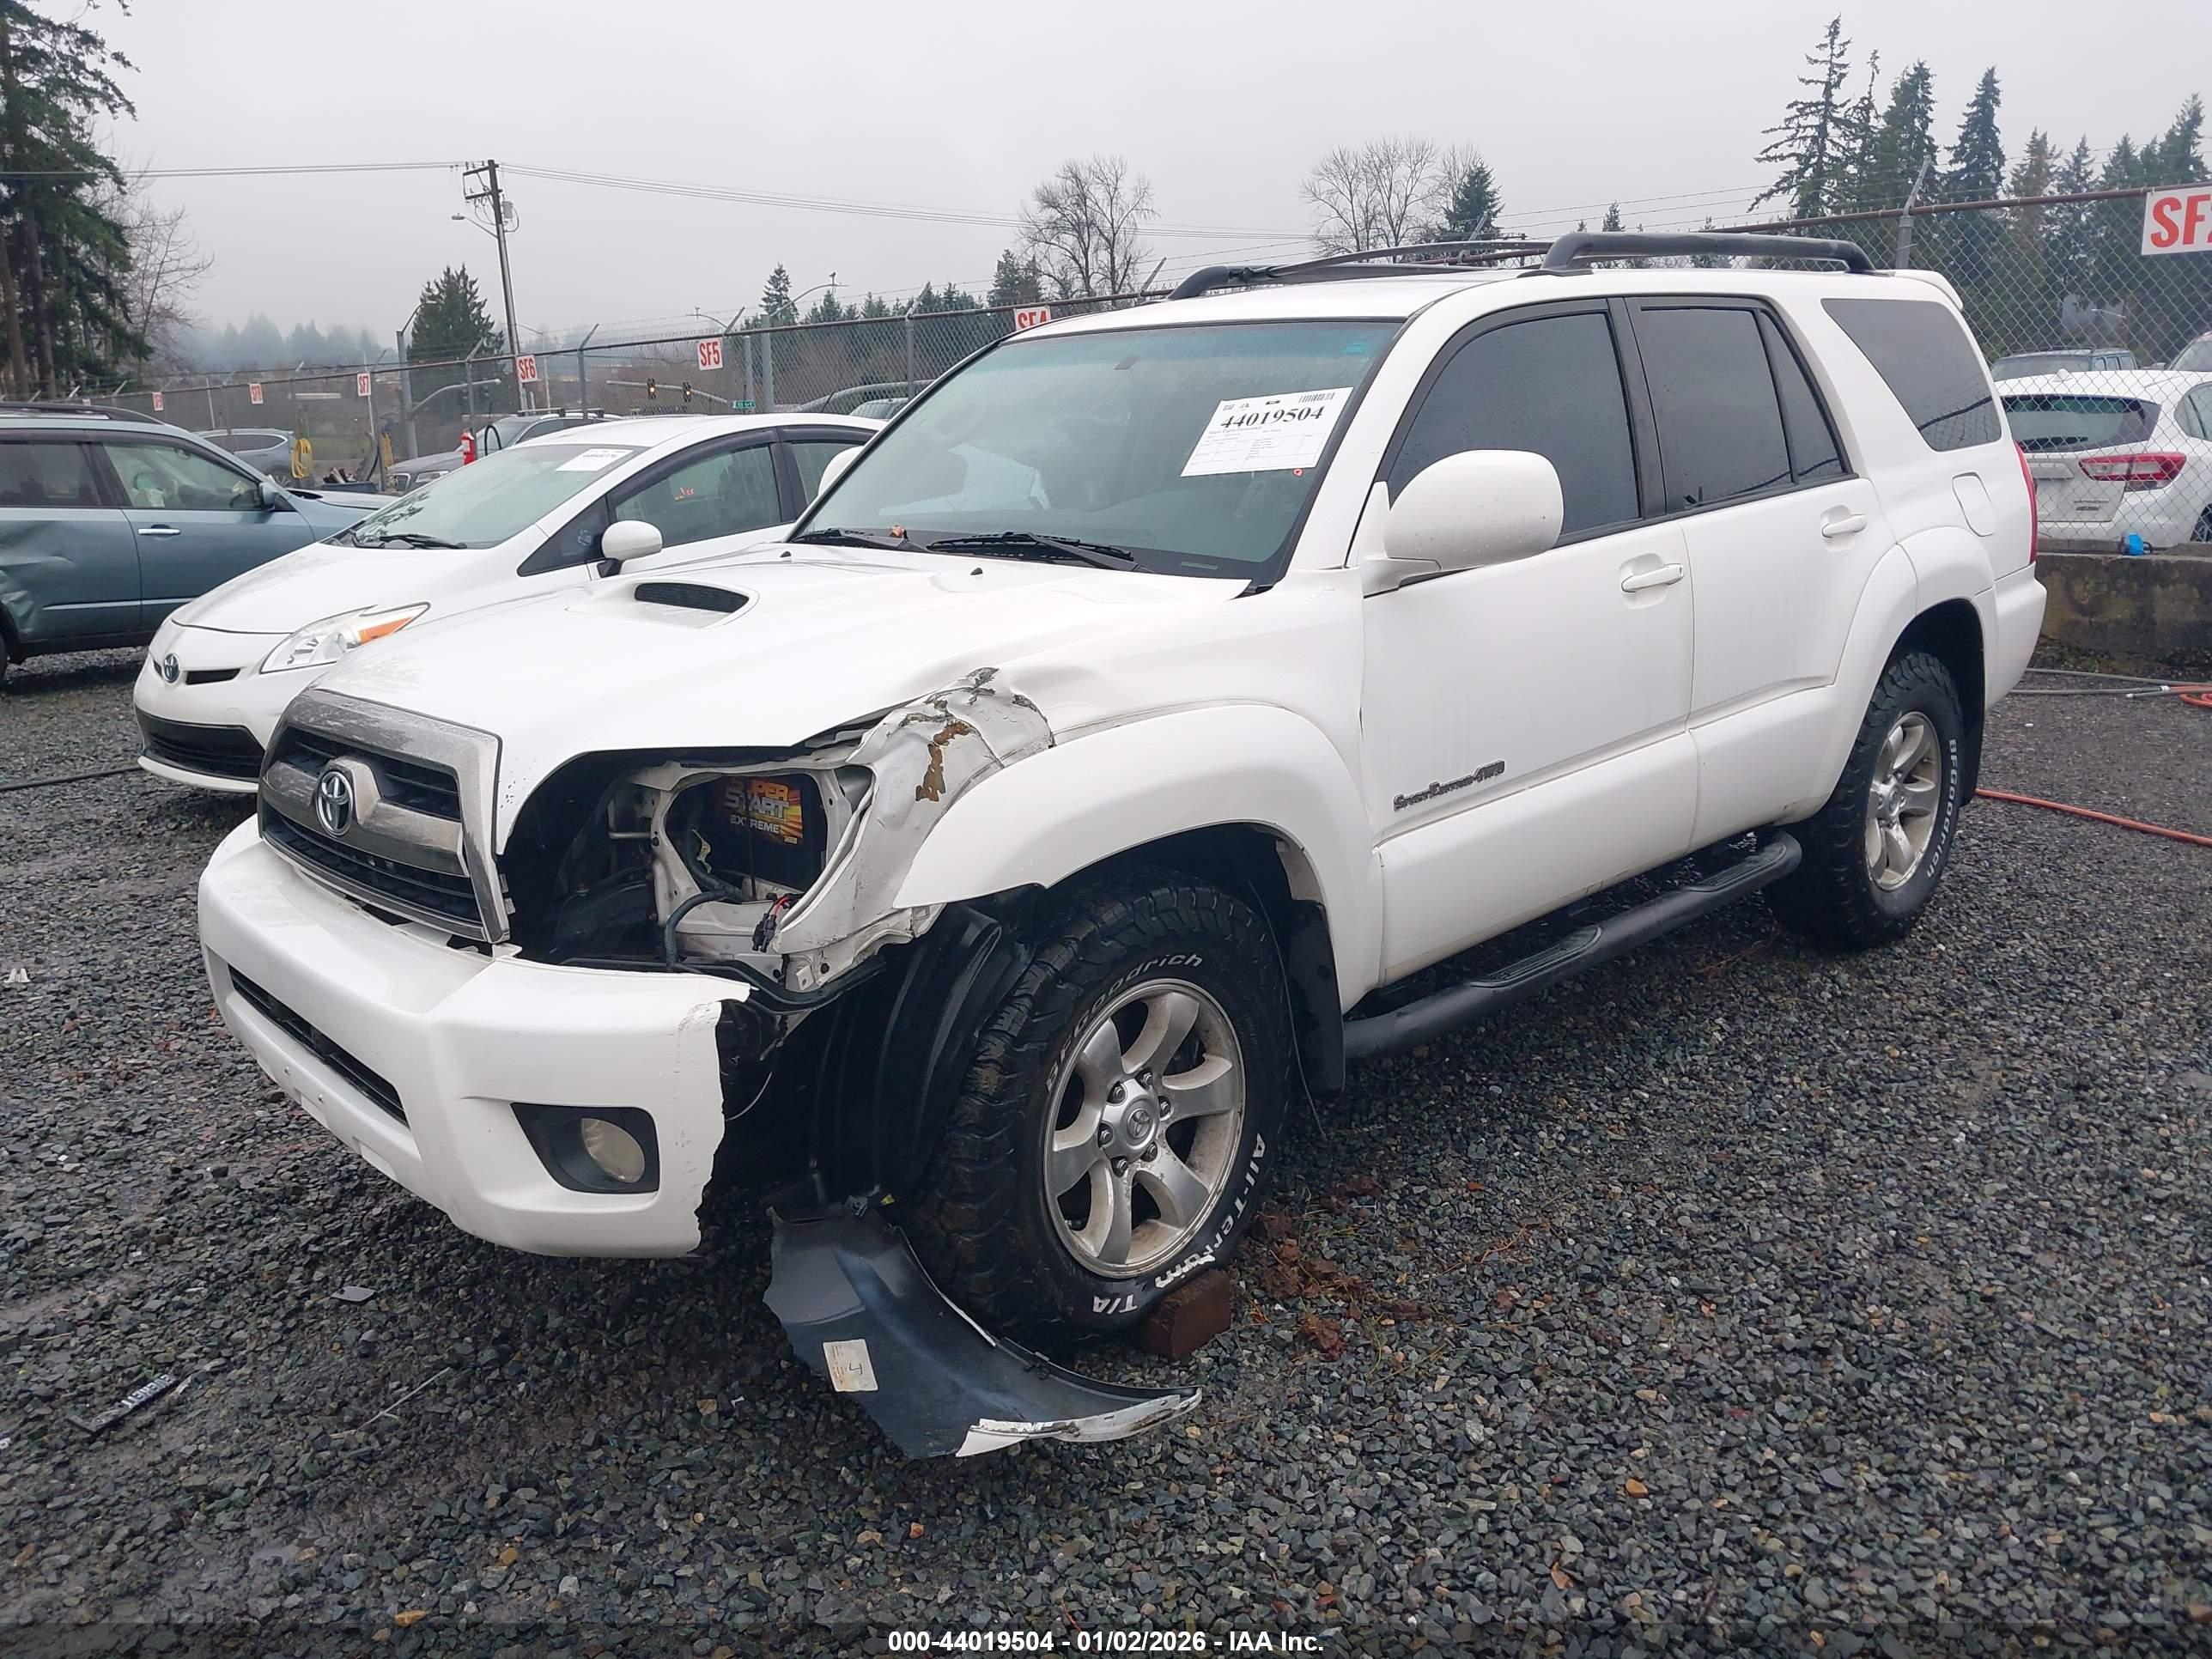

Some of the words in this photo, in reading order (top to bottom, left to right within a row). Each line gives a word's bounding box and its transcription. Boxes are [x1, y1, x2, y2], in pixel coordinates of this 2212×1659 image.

[2150, 193, 2212, 248] SF
[699, 340, 720, 367] SF5
[519, 357, 536, 380] SF6
[359, 375, 369, 394] SF7
[1219, 405, 1326, 428] 44019504
[1927, 738, 1958, 878] BFGoodrich
[1045, 953, 1203, 1093] BFGoodrich
[1092, 1293, 1139, 1316] T/A
